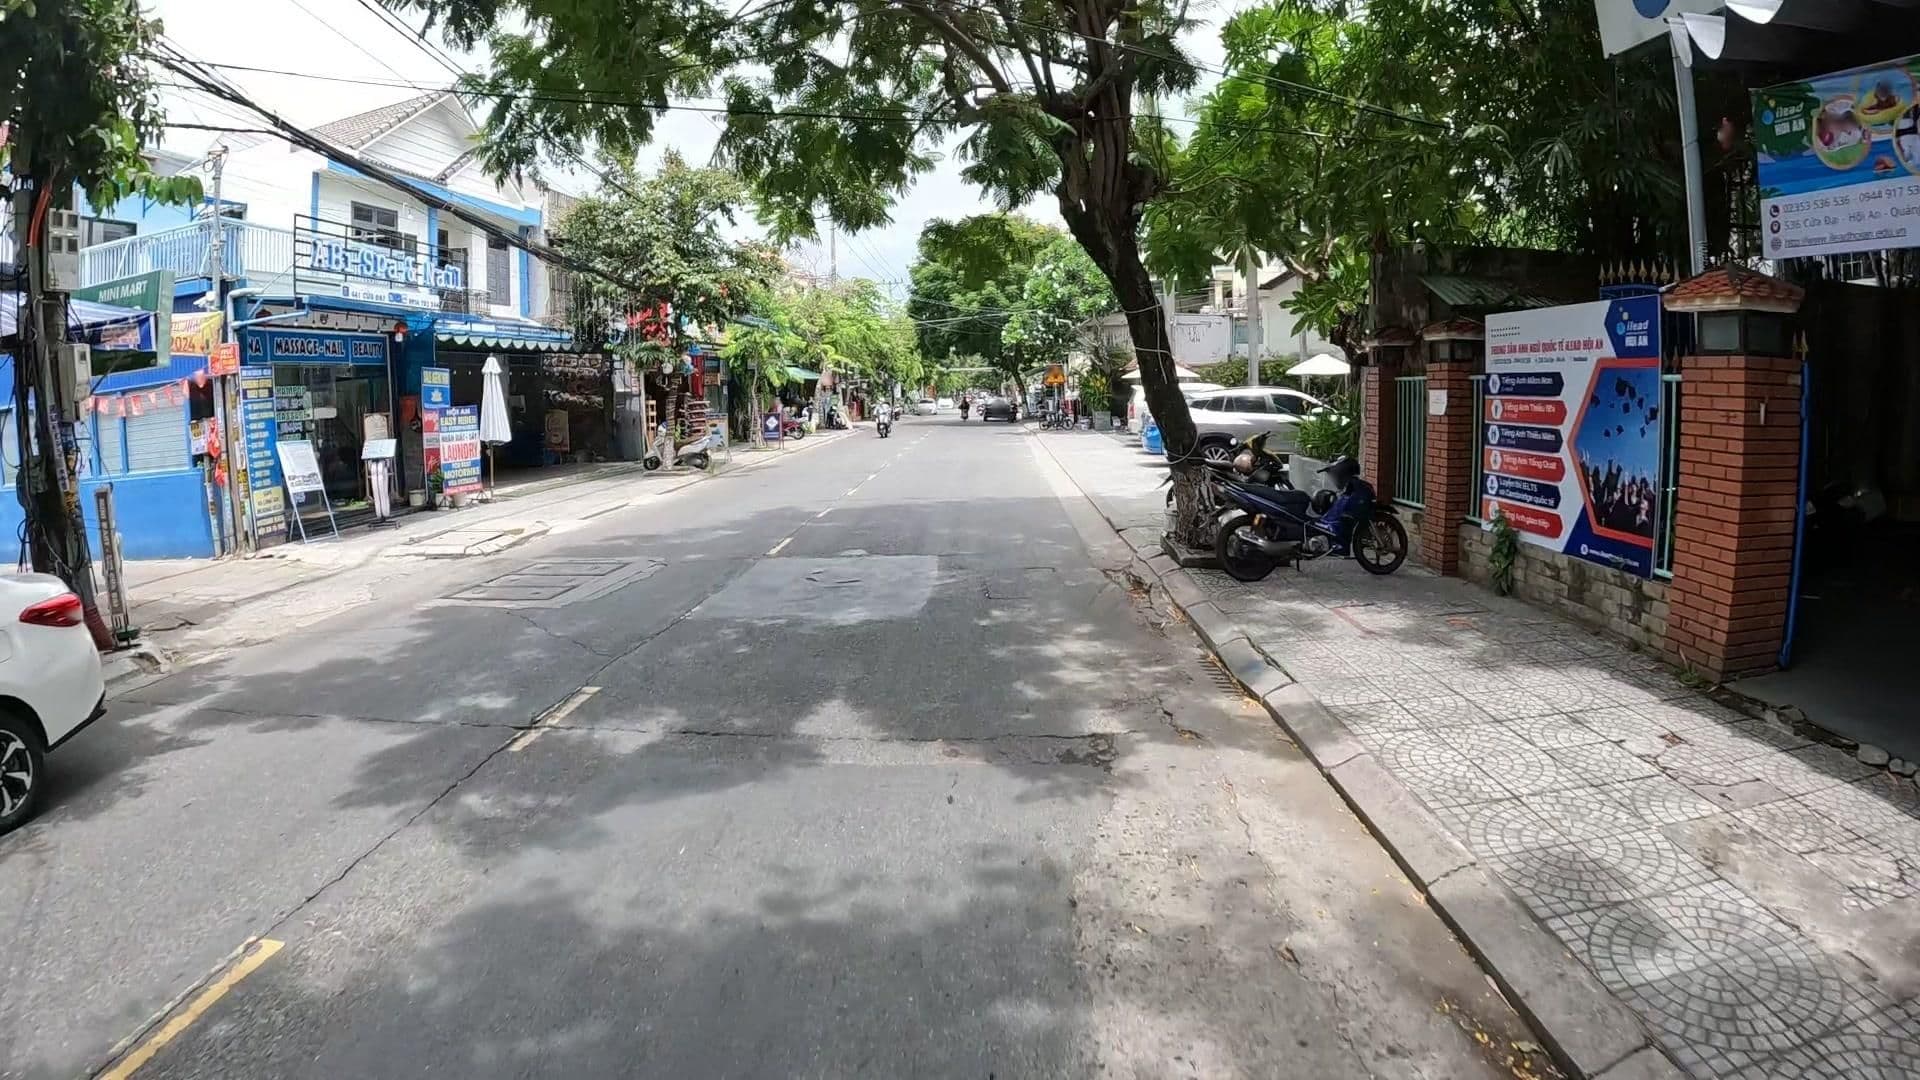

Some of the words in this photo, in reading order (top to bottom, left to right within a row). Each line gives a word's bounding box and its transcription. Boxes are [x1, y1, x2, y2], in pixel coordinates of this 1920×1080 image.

[1886, 187, 1904, 199] 917
[423, 260, 462, 290] Nail
[99, 287, 120, 302] MINI
[121, 280, 148, 299] MART
[352, 341, 383, 358] BEAUTY
[442, 442, 479, 461] LAUNDRY
